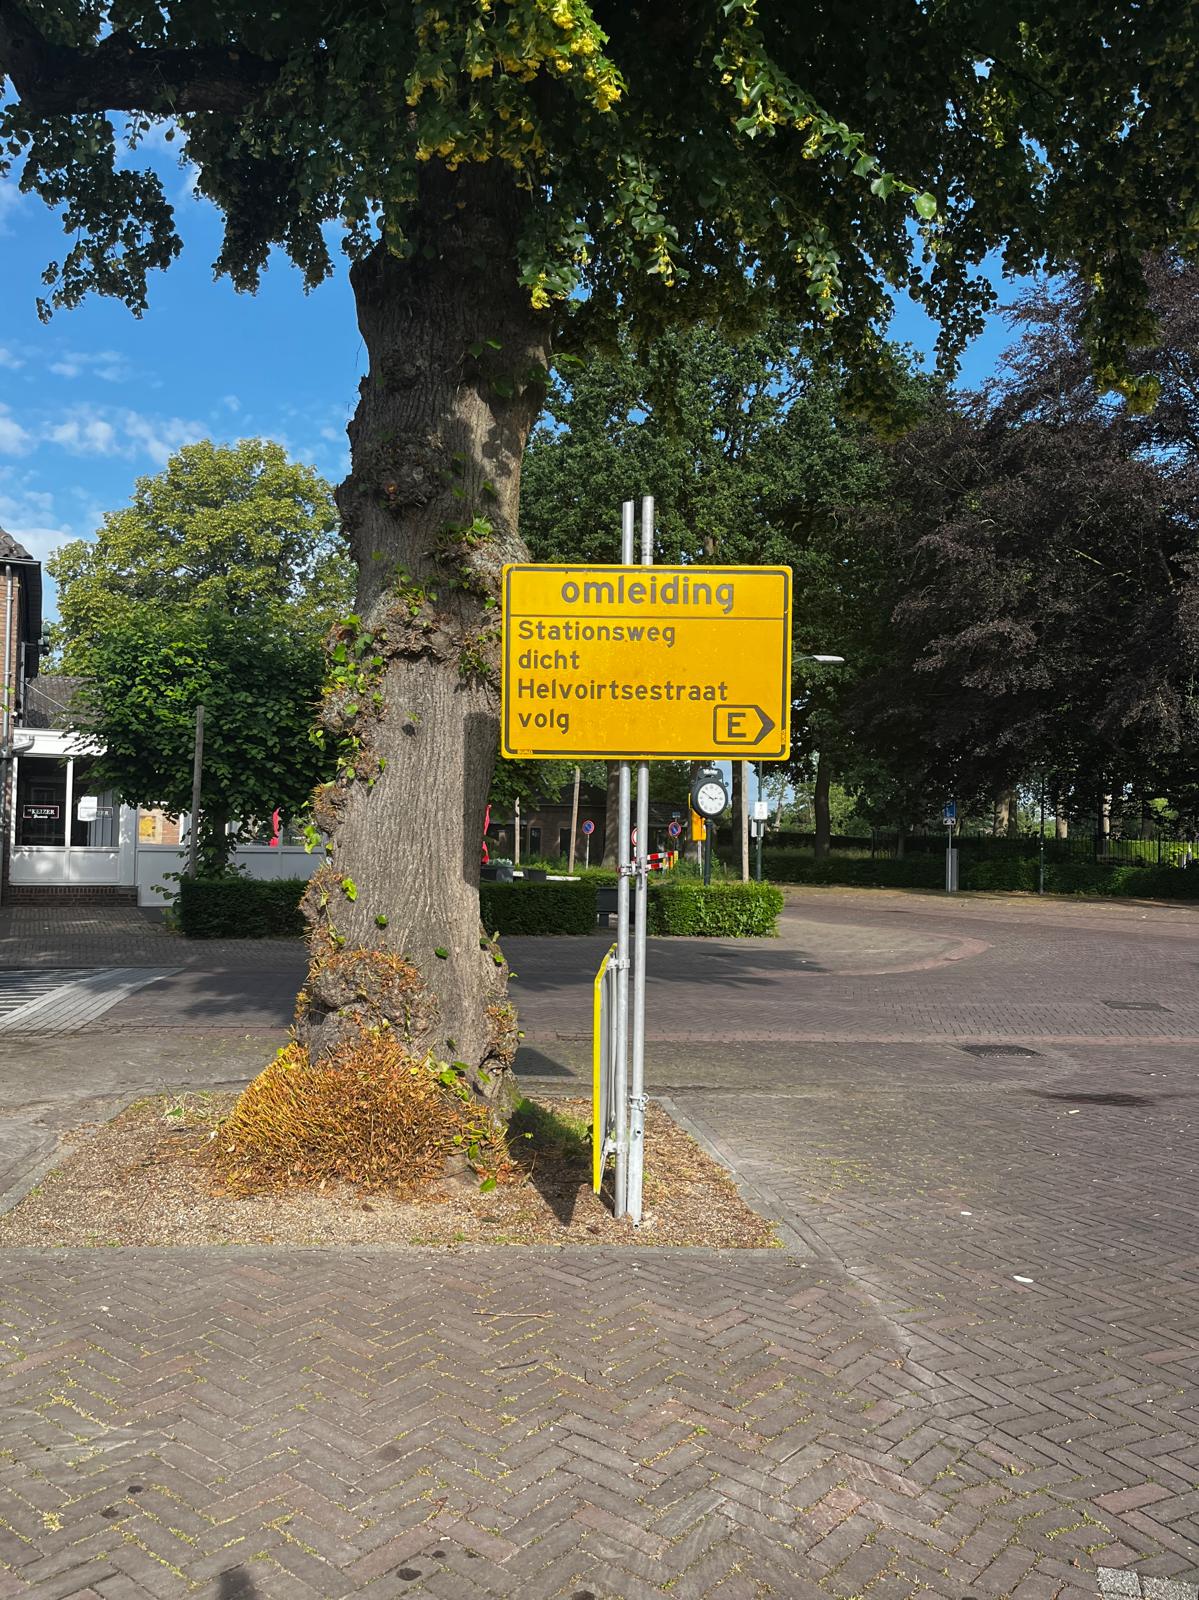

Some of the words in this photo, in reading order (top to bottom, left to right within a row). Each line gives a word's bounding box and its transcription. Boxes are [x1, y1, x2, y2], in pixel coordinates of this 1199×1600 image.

[561, 575, 734, 614] omleiding
[518, 620, 675, 648] Stationsweg
[518, 649, 580, 670] dicht
[518, 678, 728, 701] Helvoirtsestraat
[518, 709, 570, 735] volg
[727, 712, 747, 738] E
